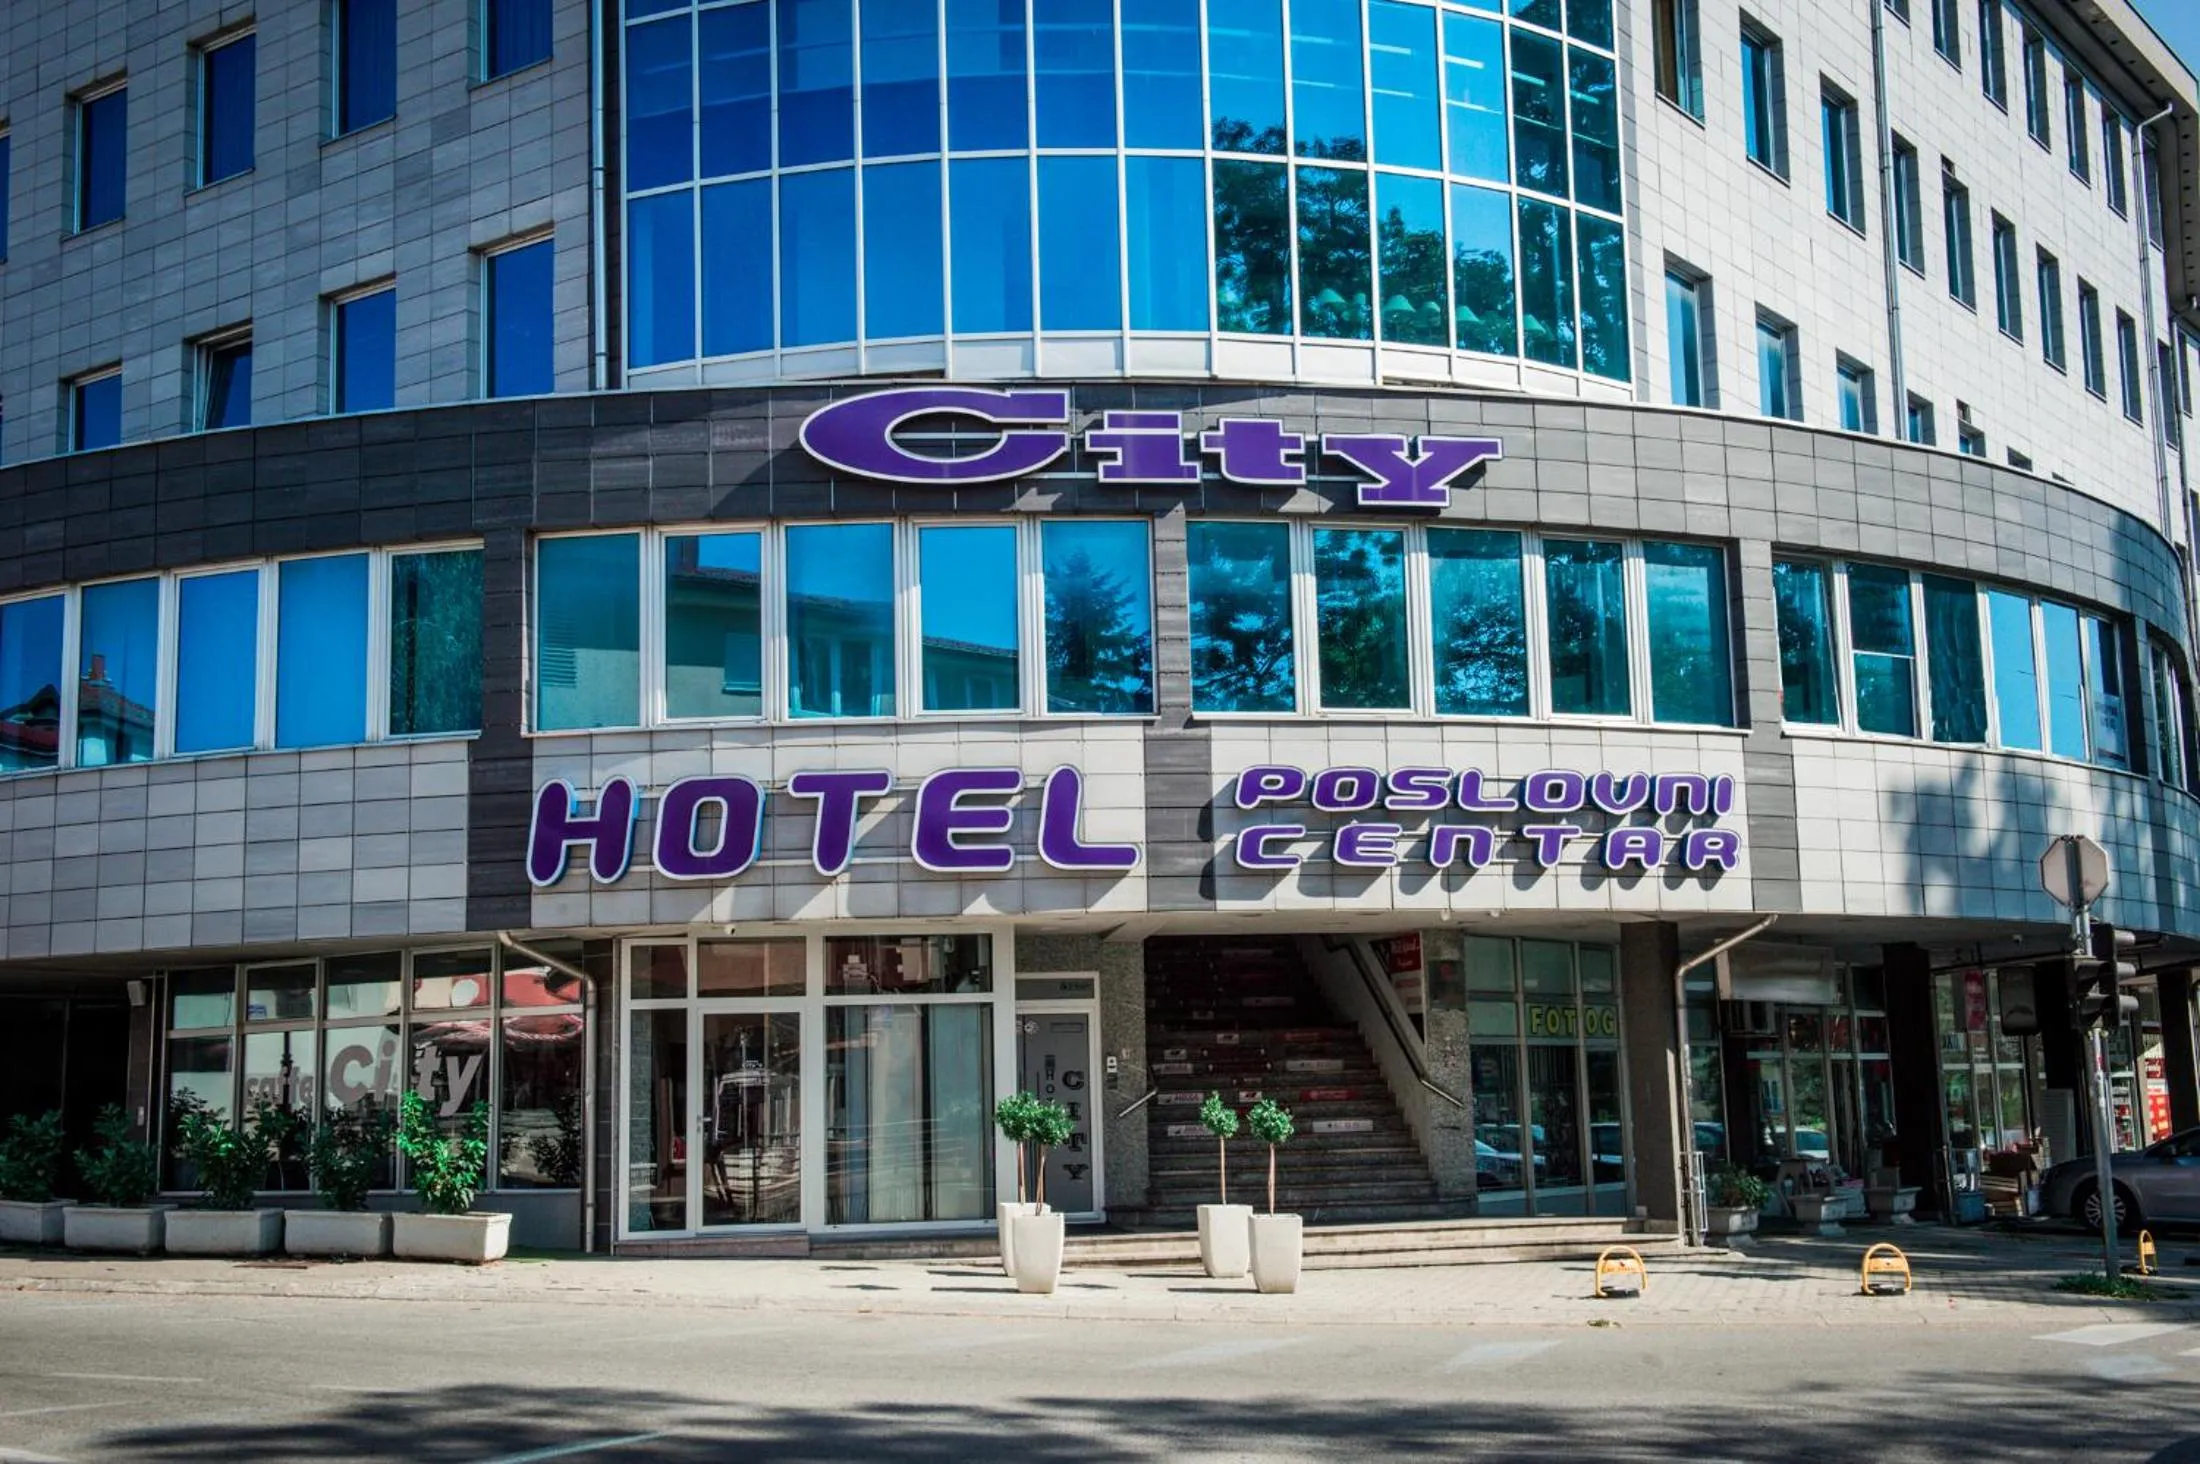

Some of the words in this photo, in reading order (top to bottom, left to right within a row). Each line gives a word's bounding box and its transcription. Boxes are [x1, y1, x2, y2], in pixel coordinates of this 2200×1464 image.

[800, 386, 1503, 509] City
[526, 764, 1141, 888] HOTEL
[1235, 764, 1736, 816] POSLOVNI
[1235, 824, 1742, 871] CENTAR
[1529, 1005, 1618, 1035] FOTOG
[329, 1039, 482, 1117] City
[1062, 1070, 1089, 1180] CITY
